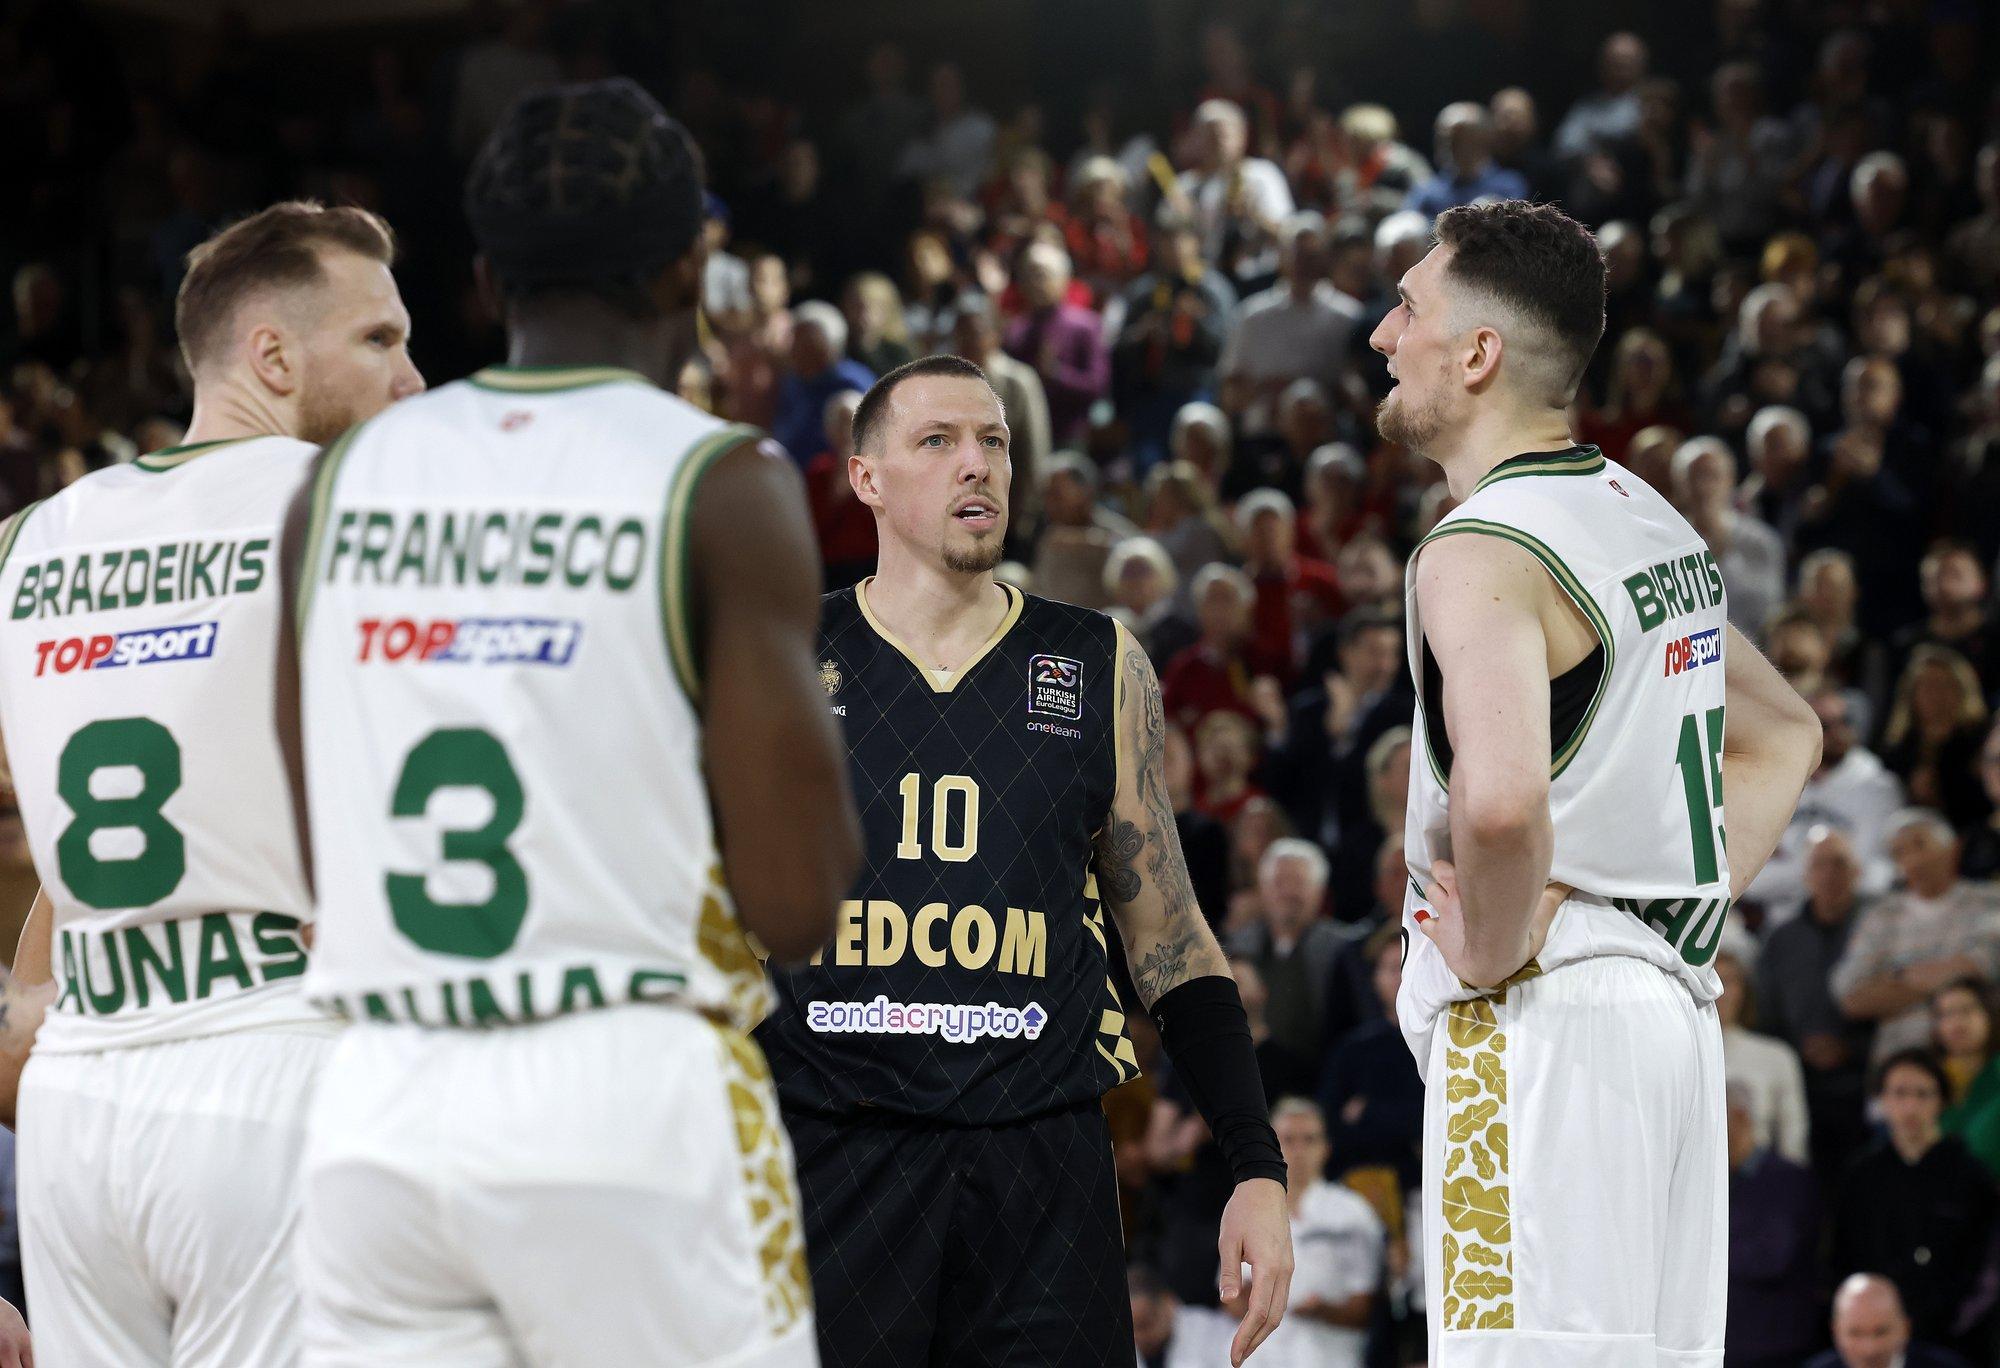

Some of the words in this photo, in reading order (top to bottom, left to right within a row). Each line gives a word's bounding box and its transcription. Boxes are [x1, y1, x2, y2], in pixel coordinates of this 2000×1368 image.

[328, 512, 645, 591] FRANCISCO
[10, 540, 270, 620] BRAZDEIKIS
[1622, 550, 1723, 634] BIRUTIS
[35, 622, 218, 678] TOPsport
[1036, 660, 1077, 688] 25
[1664, 627, 1721, 677] TOPsport
[1036, 694, 1076, 708] AIRLINES
[1036, 701, 1076, 714] EuroLeague
[1037, 687, 1076, 701] TURKISH
[1027, 722, 1081, 740] oneteam
[57, 716, 186, 910] 8
[897, 772, 980, 862] 10
[385, 727, 529, 960] 3
[809, 899, 1047, 978] EDCOM
[812, 1000, 1020, 1038] zondacrypto
